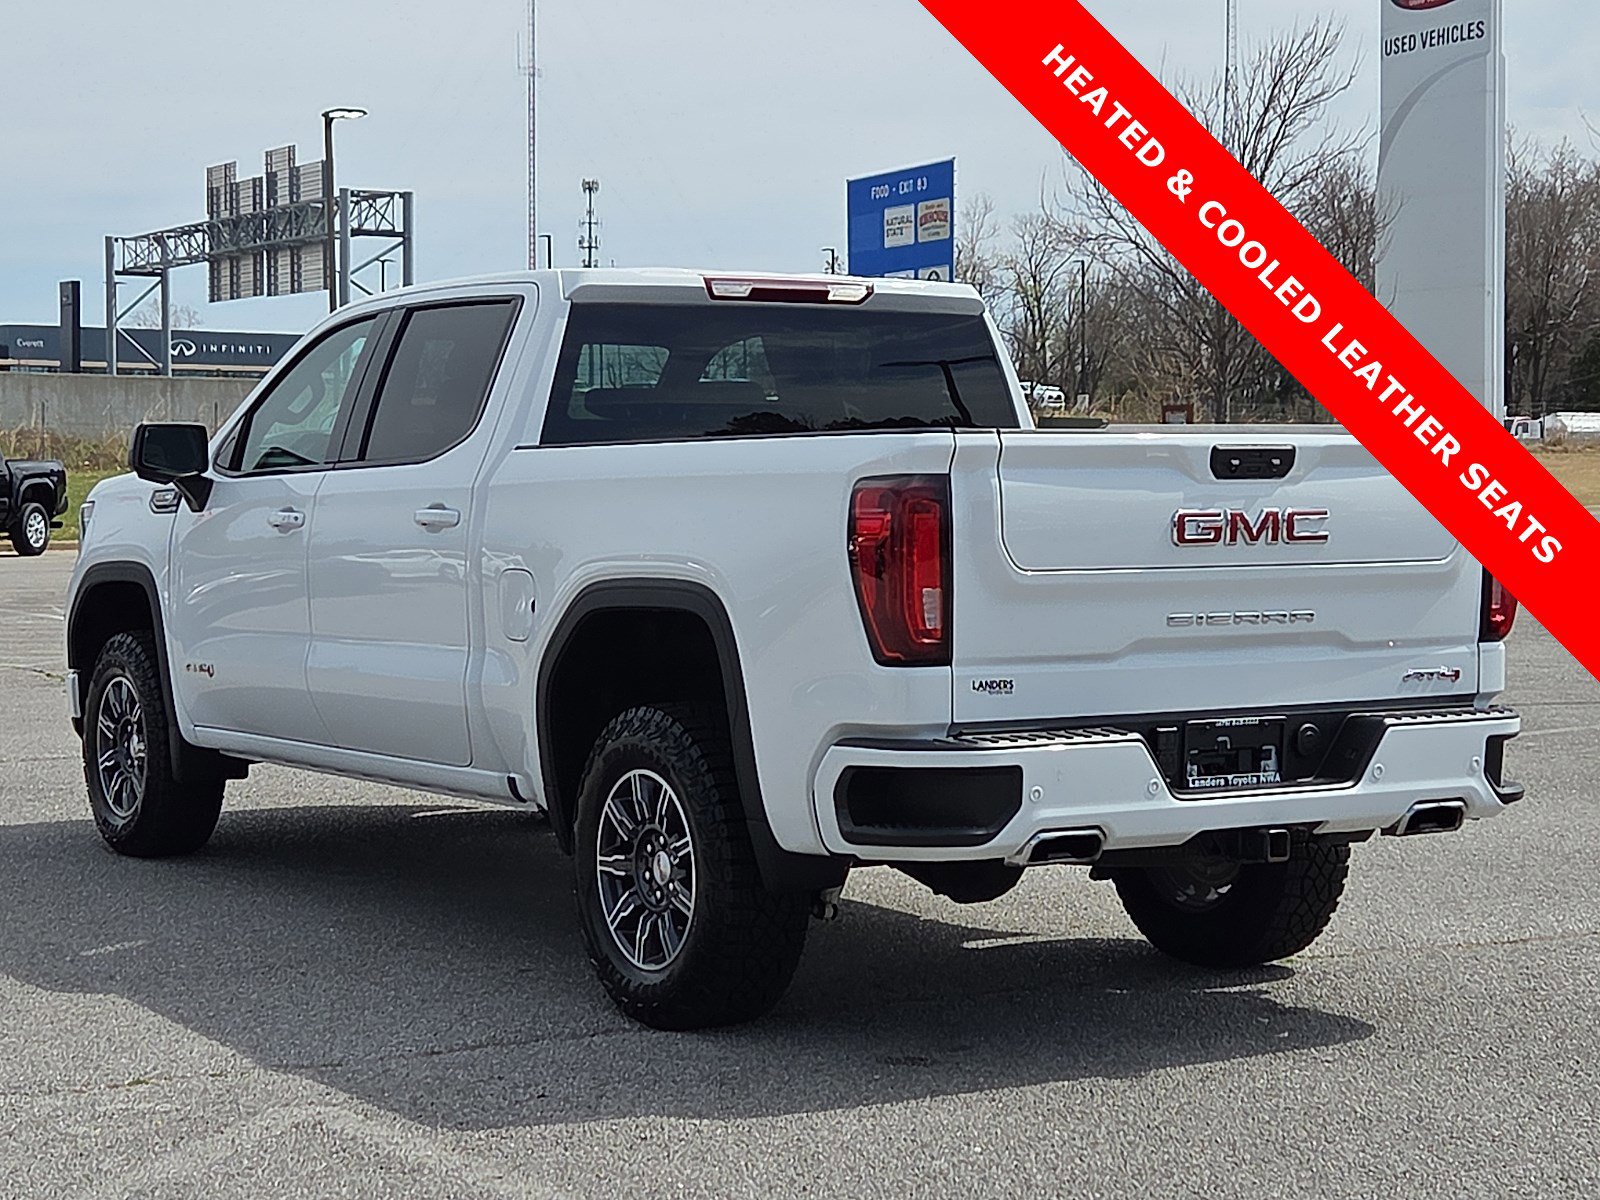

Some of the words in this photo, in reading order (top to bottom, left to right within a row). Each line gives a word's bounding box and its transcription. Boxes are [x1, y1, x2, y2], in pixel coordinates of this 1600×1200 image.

[1384, 34, 1417, 57] USED
[1420, 20, 1485, 50] VEHICLES
[871, 184, 890, 200] FOOD
[899, 179, 914, 195] EXIT
[202, 343, 270, 355] INFINITI
[1171, 507, 1330, 547] GMC
[1166, 609, 1315, 627] SIERRA
[972, 679, 1014, 692] LANDERS
[1189, 778, 1225, 788] Landers
[1228, 775, 1257, 786] Toyota
[1260, 772, 1280, 784] NWA
